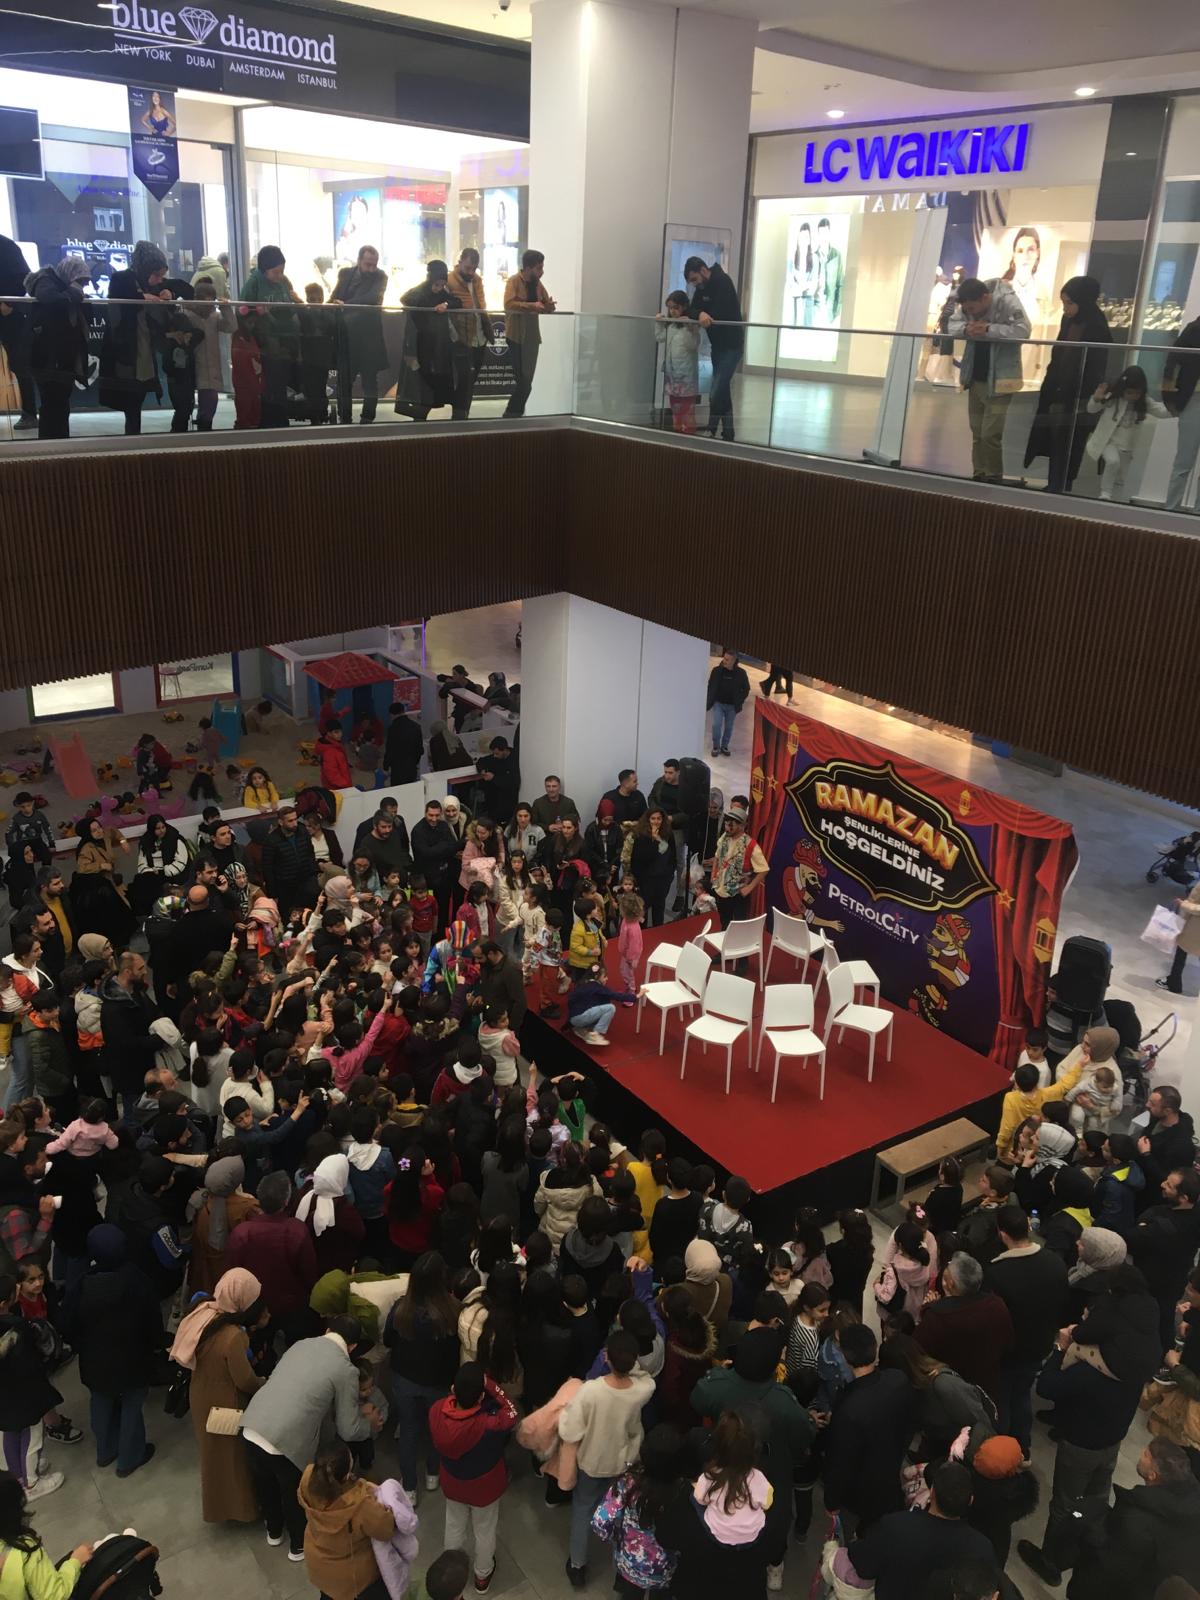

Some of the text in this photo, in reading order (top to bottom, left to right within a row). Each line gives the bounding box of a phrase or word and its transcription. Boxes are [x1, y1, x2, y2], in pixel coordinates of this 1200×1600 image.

[111, 0, 337, 65] blue diamond
[114, 43, 338, 89] NEW YORK DUBAI AMSTERDAM ISTANBUL
[803, 138, 851, 184] LC
[528, 835, 537, 846] R
[814, 781, 960, 870] RAMAZAN
[844, 816, 920, 859] ŞENLİKLERİNE
[820, 818, 945, 892] HOŞGELDİNİZ
